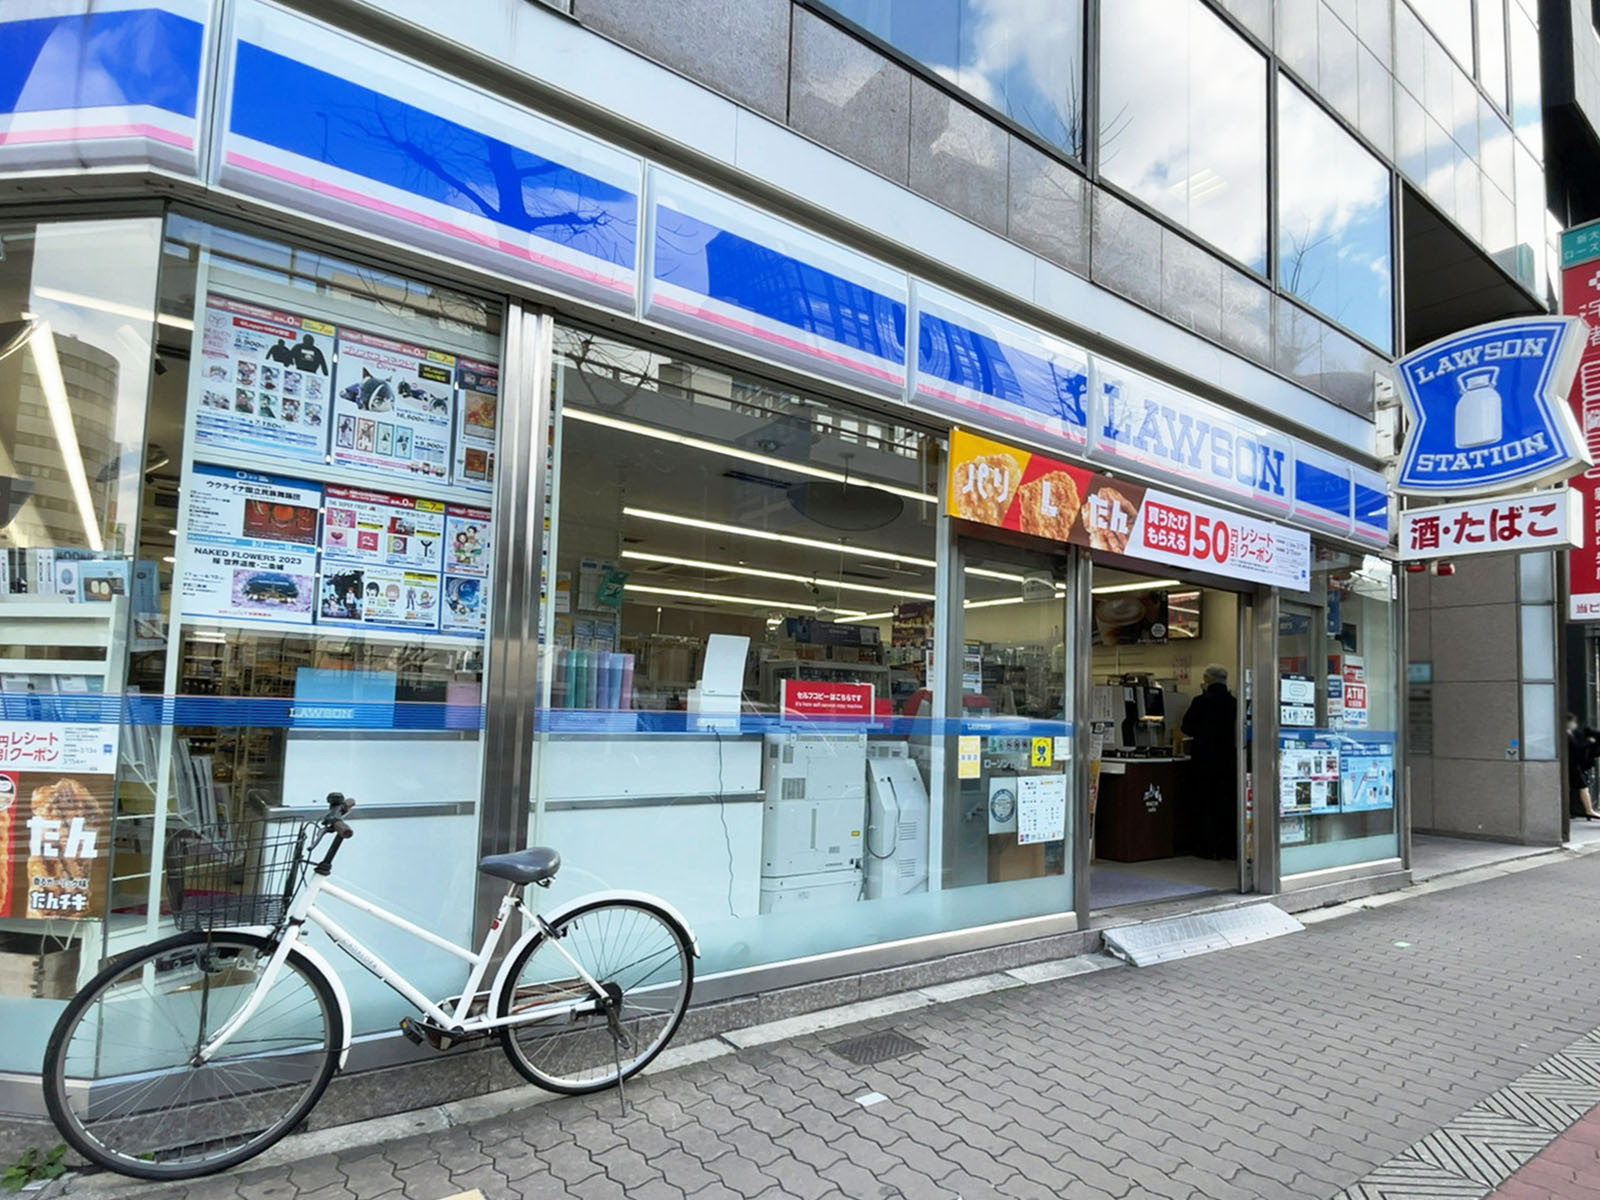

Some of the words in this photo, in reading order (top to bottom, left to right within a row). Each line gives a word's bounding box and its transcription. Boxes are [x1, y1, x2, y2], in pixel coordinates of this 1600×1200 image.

[1414, 337, 1548, 385] LAWSON
[1103, 382, 1285, 497] LAWSON
[1416, 432, 1549, 473] STATION
[962, 462, 1010, 504] パリ
[1087, 492, 1129, 534] たん
[1147, 504, 1188, 531] 買うたび
[1410, 502, 1558, 550] 酒・たばこ
[1147, 526, 1188, 551] もらえる
[1192, 514, 1230, 564] 50
[1240, 526, 1275, 548] レシート
[194, 546, 230, 558] NAKED
[231, 551, 276, 563] FLOWERS
[278, 556, 302, 565] 2023
[1239, 543, 1275, 564] クーポン
[796, 691, 862, 702] セルフコピーはこちらです
[1346, 687, 1364, 700] ATM
[288, 707, 354, 719] LAWSON
[11, 731, 59, 746] レシート
[10, 748, 59, 762] クーポン
[26, 815, 98, 858] たん
[31, 891, 87, 911] たんチキ
